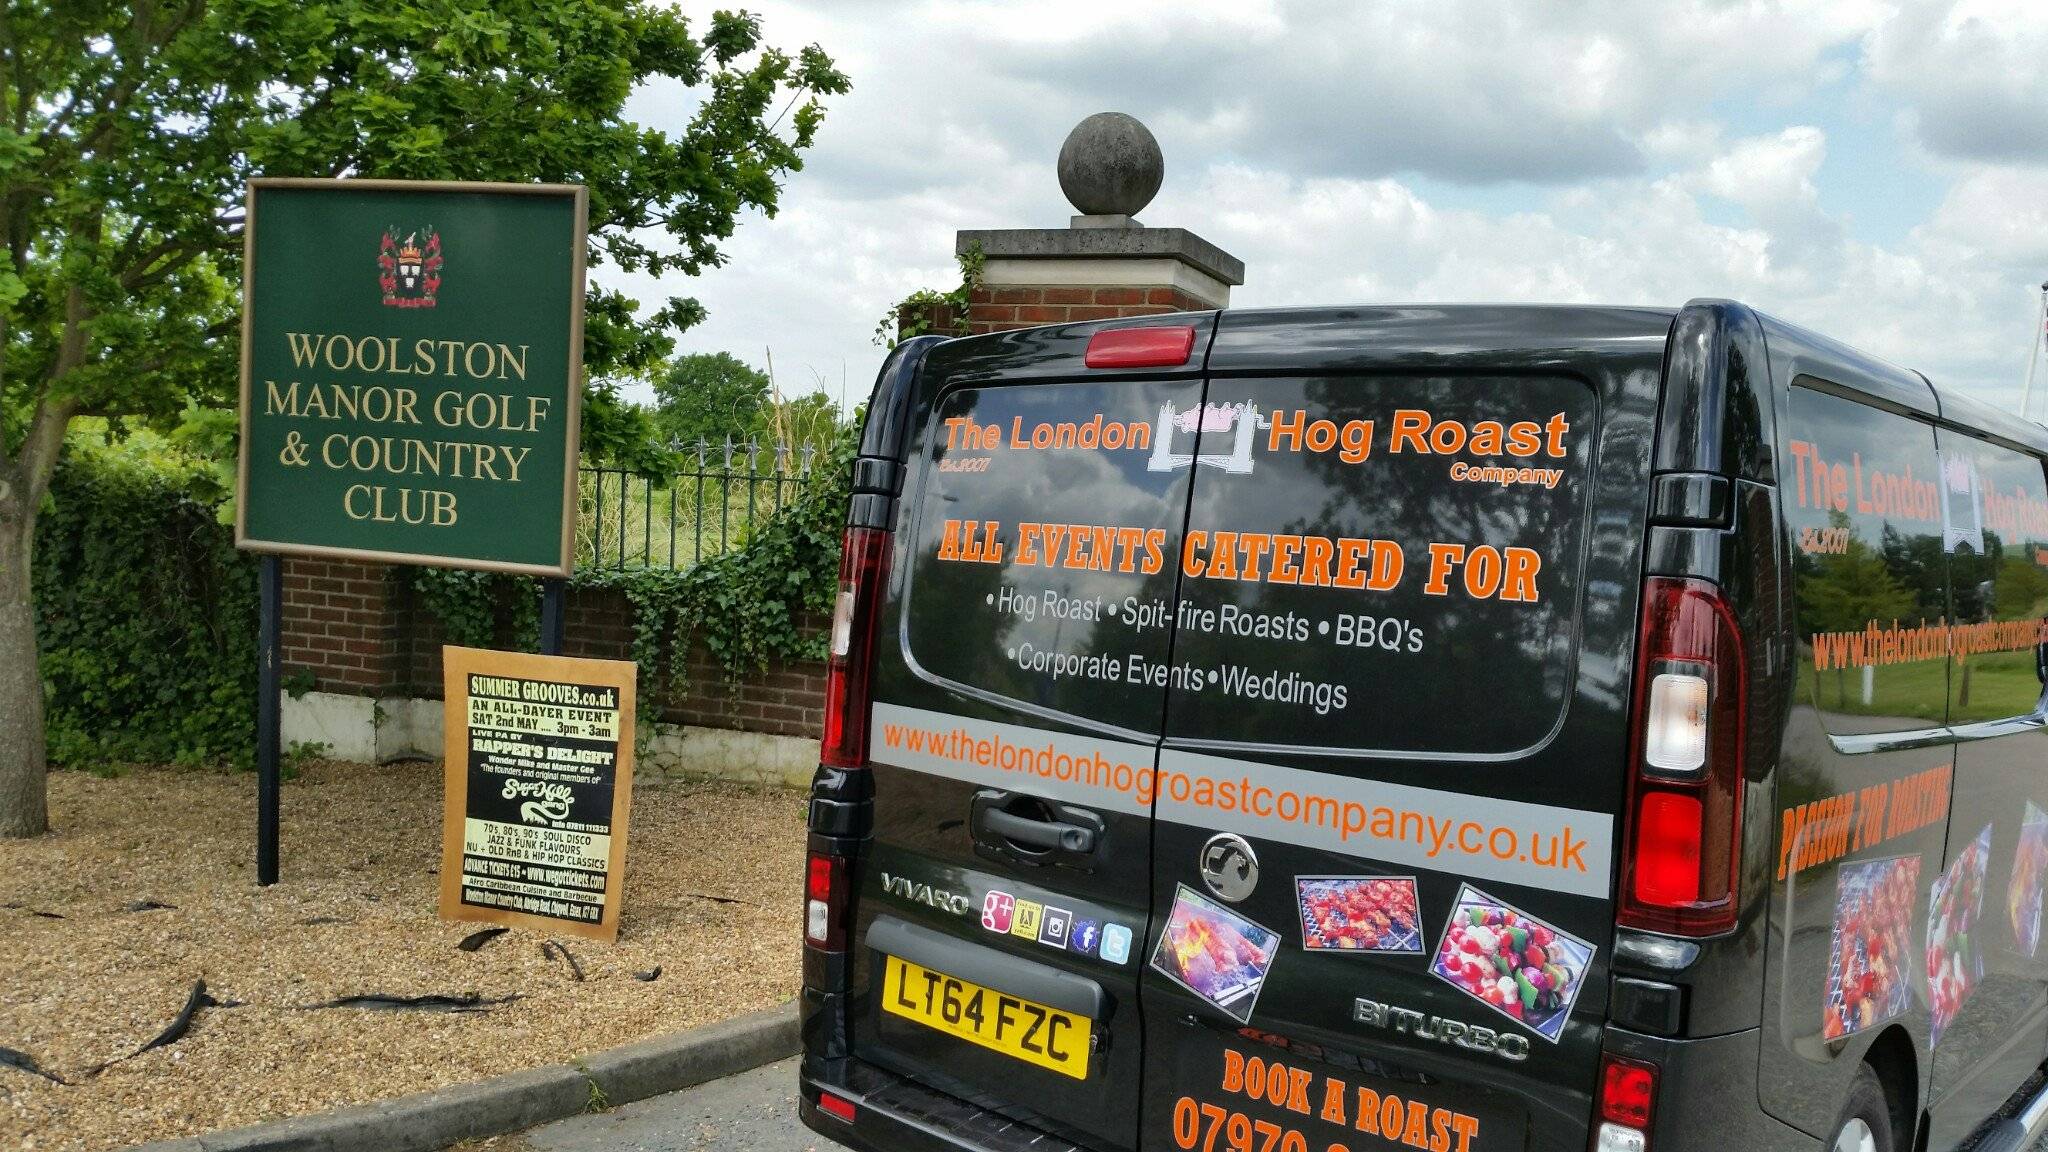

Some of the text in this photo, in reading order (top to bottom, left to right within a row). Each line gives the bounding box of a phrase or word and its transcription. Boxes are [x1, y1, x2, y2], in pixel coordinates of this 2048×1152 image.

[285, 332, 530, 380] WOOLSTON
[263, 380, 552, 433] MANOR GOLF
[280, 430, 532, 482] & COUNTRY
[943, 409, 1569, 464] The London Hog Roast
[1450, 461, 1564, 490] Company
[1790, 438, 1848, 513] The
[1852, 451, 1941, 522] London
[344, 484, 458, 527] CLUB
[936, 519, 1543, 604] ALL EVENTS CATERED FOR
[998, 586, 1425, 653] Hog Roast Spit-fire Roasts BBQ's
[471, 676, 615, 708] SUMMER GROOVES.co.uk
[1018, 642, 1349, 715] Corporate Events Weddings
[472, 700, 612, 724] AN ALL-DAYER EVENT
[472, 712, 493, 726] SAT
[496, 714, 514, 728] 2nd
[517, 717, 538, 730] MAY
[557, 721, 579, 736] 3pm
[588, 724, 611, 738] 3am
[472, 728, 523, 741] LIVE PA BY
[472, 738, 614, 765] RAPPER'S DELIGHT
[488, 755, 516, 766] Wonder
[536, 760, 550, 770] and
[551, 762, 579, 773] Master
[580, 765, 595, 775] Gee
[494, 764, 522, 776] founders
[522, 768, 535, 778] and
[535, 769, 559, 781] original
[559, 772, 590, 784] members
[883, 720, 1591, 873] www.thelondonhogroastcompany.co.uk
[466, 842, 478, 852] NU
[488, 845, 504, 856] OLD
[506, 848, 522, 858] RnB
[524, 850, 530, 860] &
[532, 851, 546, 862] HIP
[548, 853, 565, 865] HOP
[567, 855, 606, 870] CLASSICS
[487, 834, 505, 845] JAZZ
[507, 837, 512, 847] &
[515, 838, 537, 850] FUNK
[544, 831, 564, 843] SOUL
[566, 834, 591, 846] DISCO
[464, 858, 489, 875] ADVANCE
[488, 860, 510, 877] TICKETS
[468, 877, 598, 904] Afro Caribbean Cuisine and Barbecue
[880, 871, 970, 916] VIVARO
[898, 963, 1073, 1063] LT64 FZC
[1352, 996, 1530, 1061] BITURBO
[1222, 1048, 1479, 1152] BOOK A ROAST
